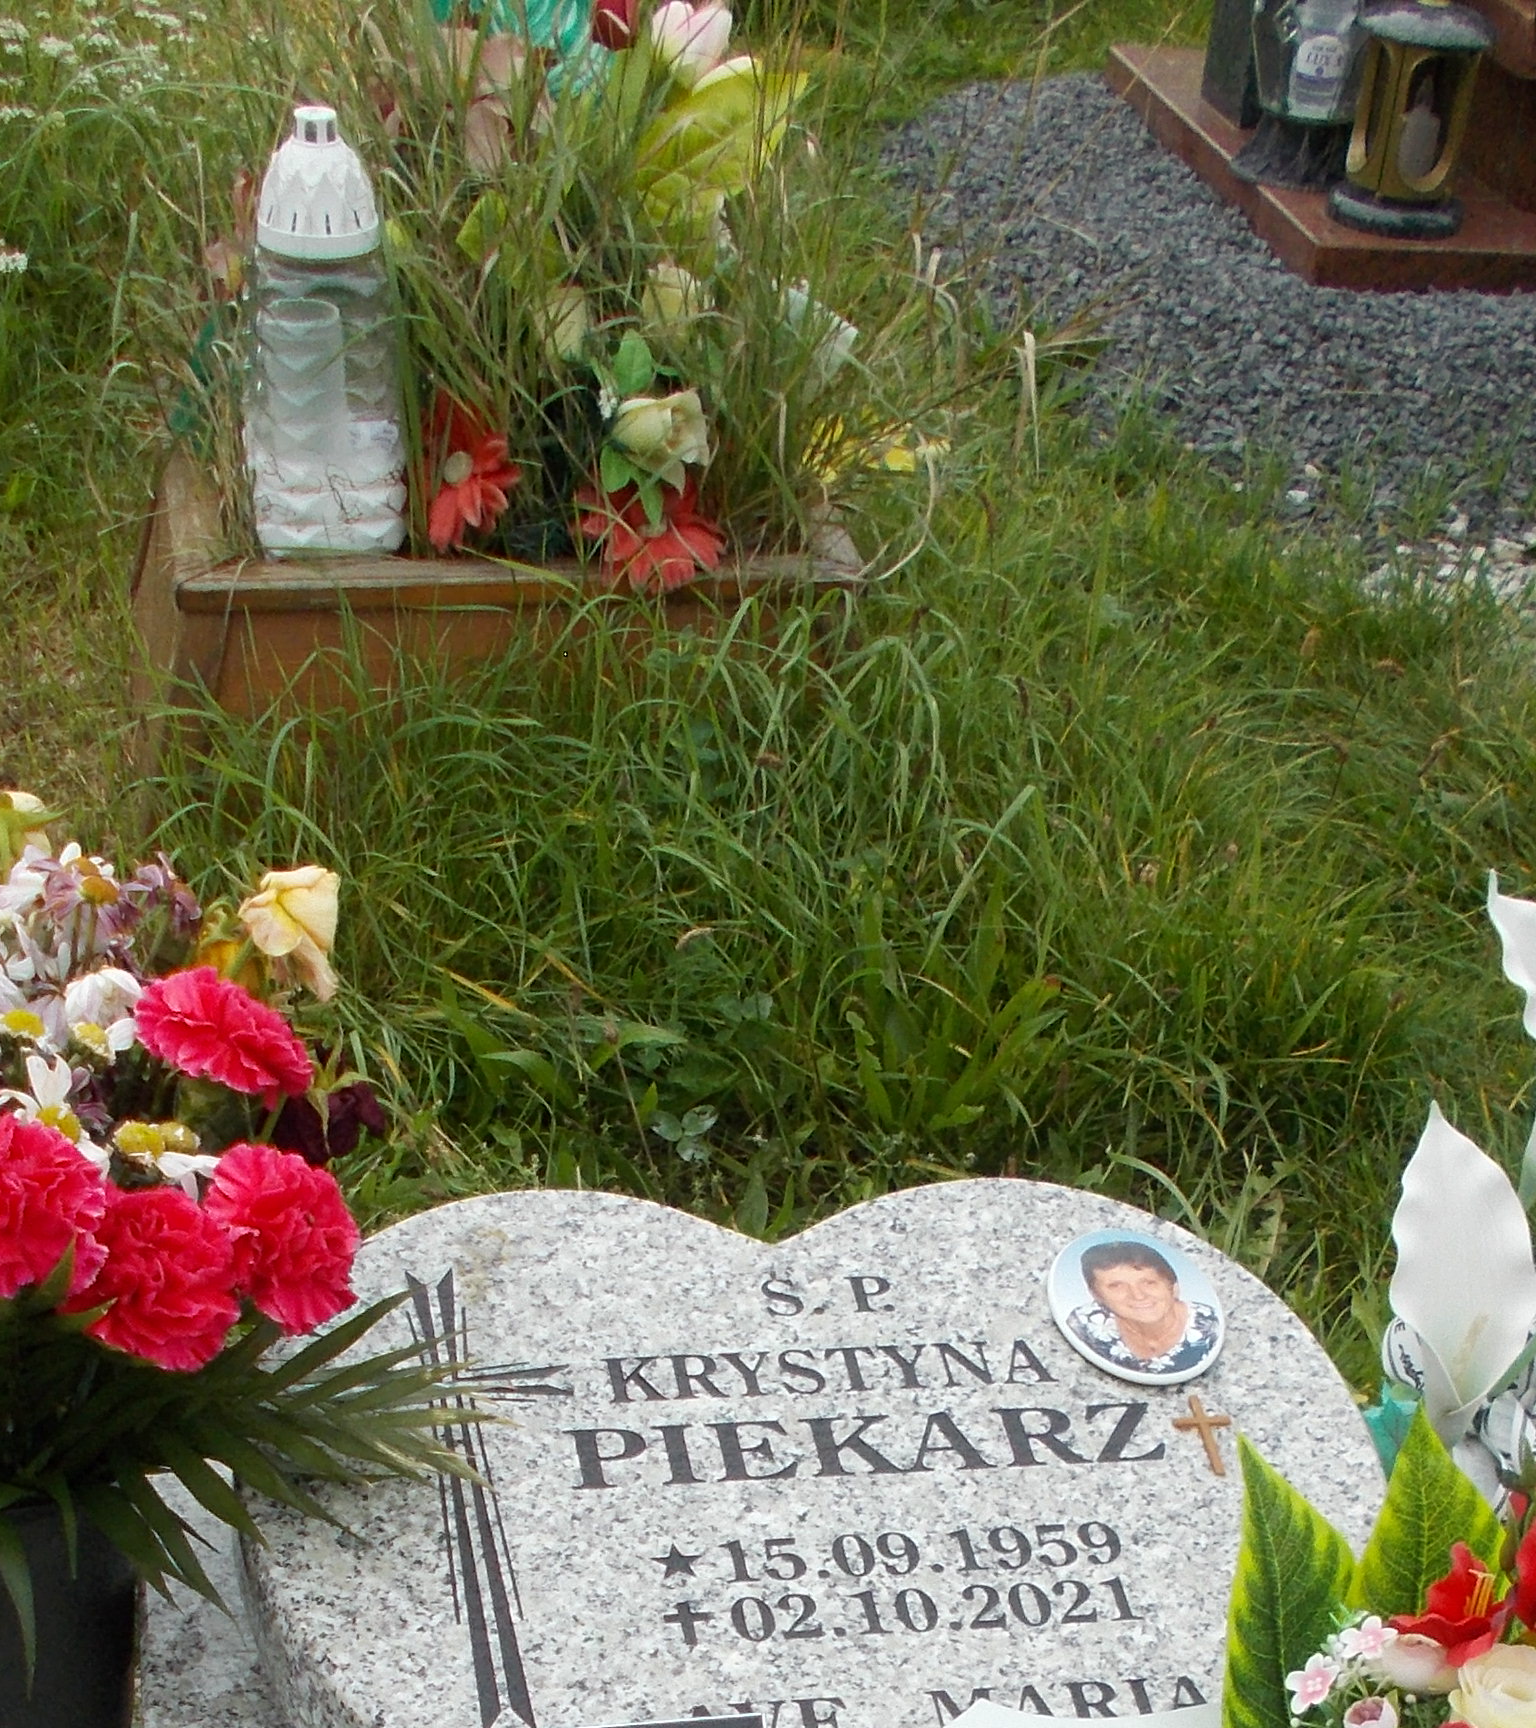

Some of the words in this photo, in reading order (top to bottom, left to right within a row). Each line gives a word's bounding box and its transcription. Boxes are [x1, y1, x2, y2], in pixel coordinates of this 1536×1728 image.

[843, 1275, 895, 1313] P.
[602, 1338, 1059, 1402] KRYSTYNA
[562, 1401, 1166, 1490] PIEKARZ
[719, 1520, 1122, 1583] 15.09.1959
[730, 1576, 1144, 1642] 02.10.2021
